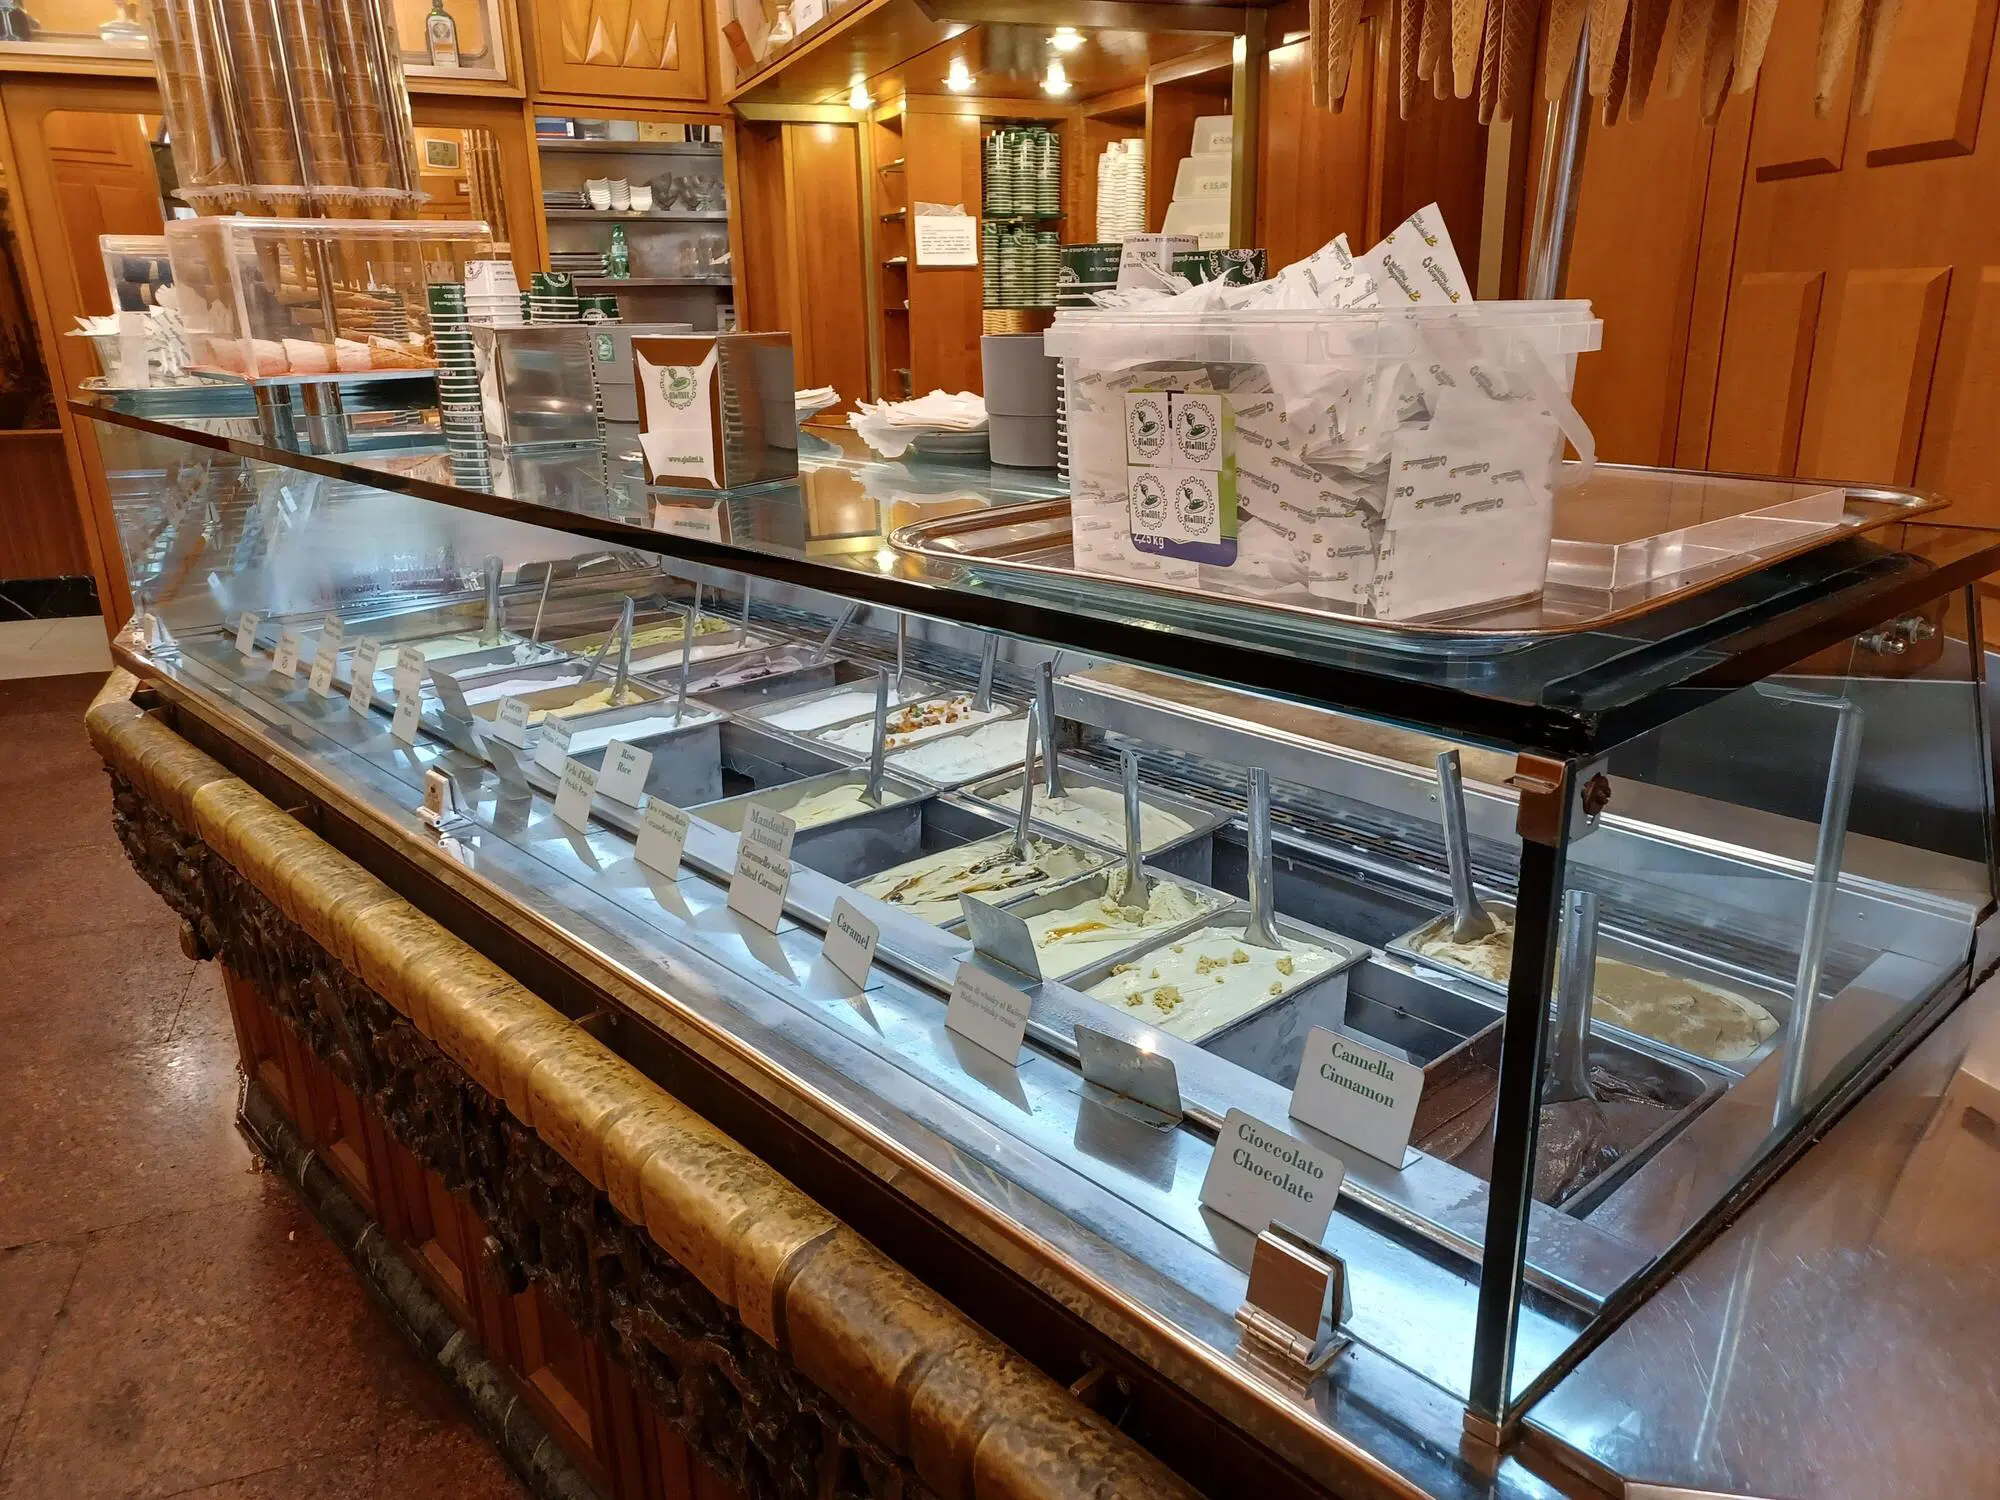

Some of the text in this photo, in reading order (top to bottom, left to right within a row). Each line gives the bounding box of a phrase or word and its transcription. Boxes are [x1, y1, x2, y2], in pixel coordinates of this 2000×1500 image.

[616, 761, 631, 775] Rice
[621, 748, 636, 762] Riso
[750, 809, 789, 837] Mandorla
[750, 828, 783, 852] Almond
[742, 845, 771, 870] Caramello
[739, 862, 783, 896] Salted Caramel
[836, 912, 870, 950] Caramel
[1331, 1042, 1395, 1082] Cannella
[1320, 1063, 1394, 1108] Cinnamon
[1238, 1123, 1324, 1180] Cioccolato
[1232, 1149, 1314, 1203] Chocolate
